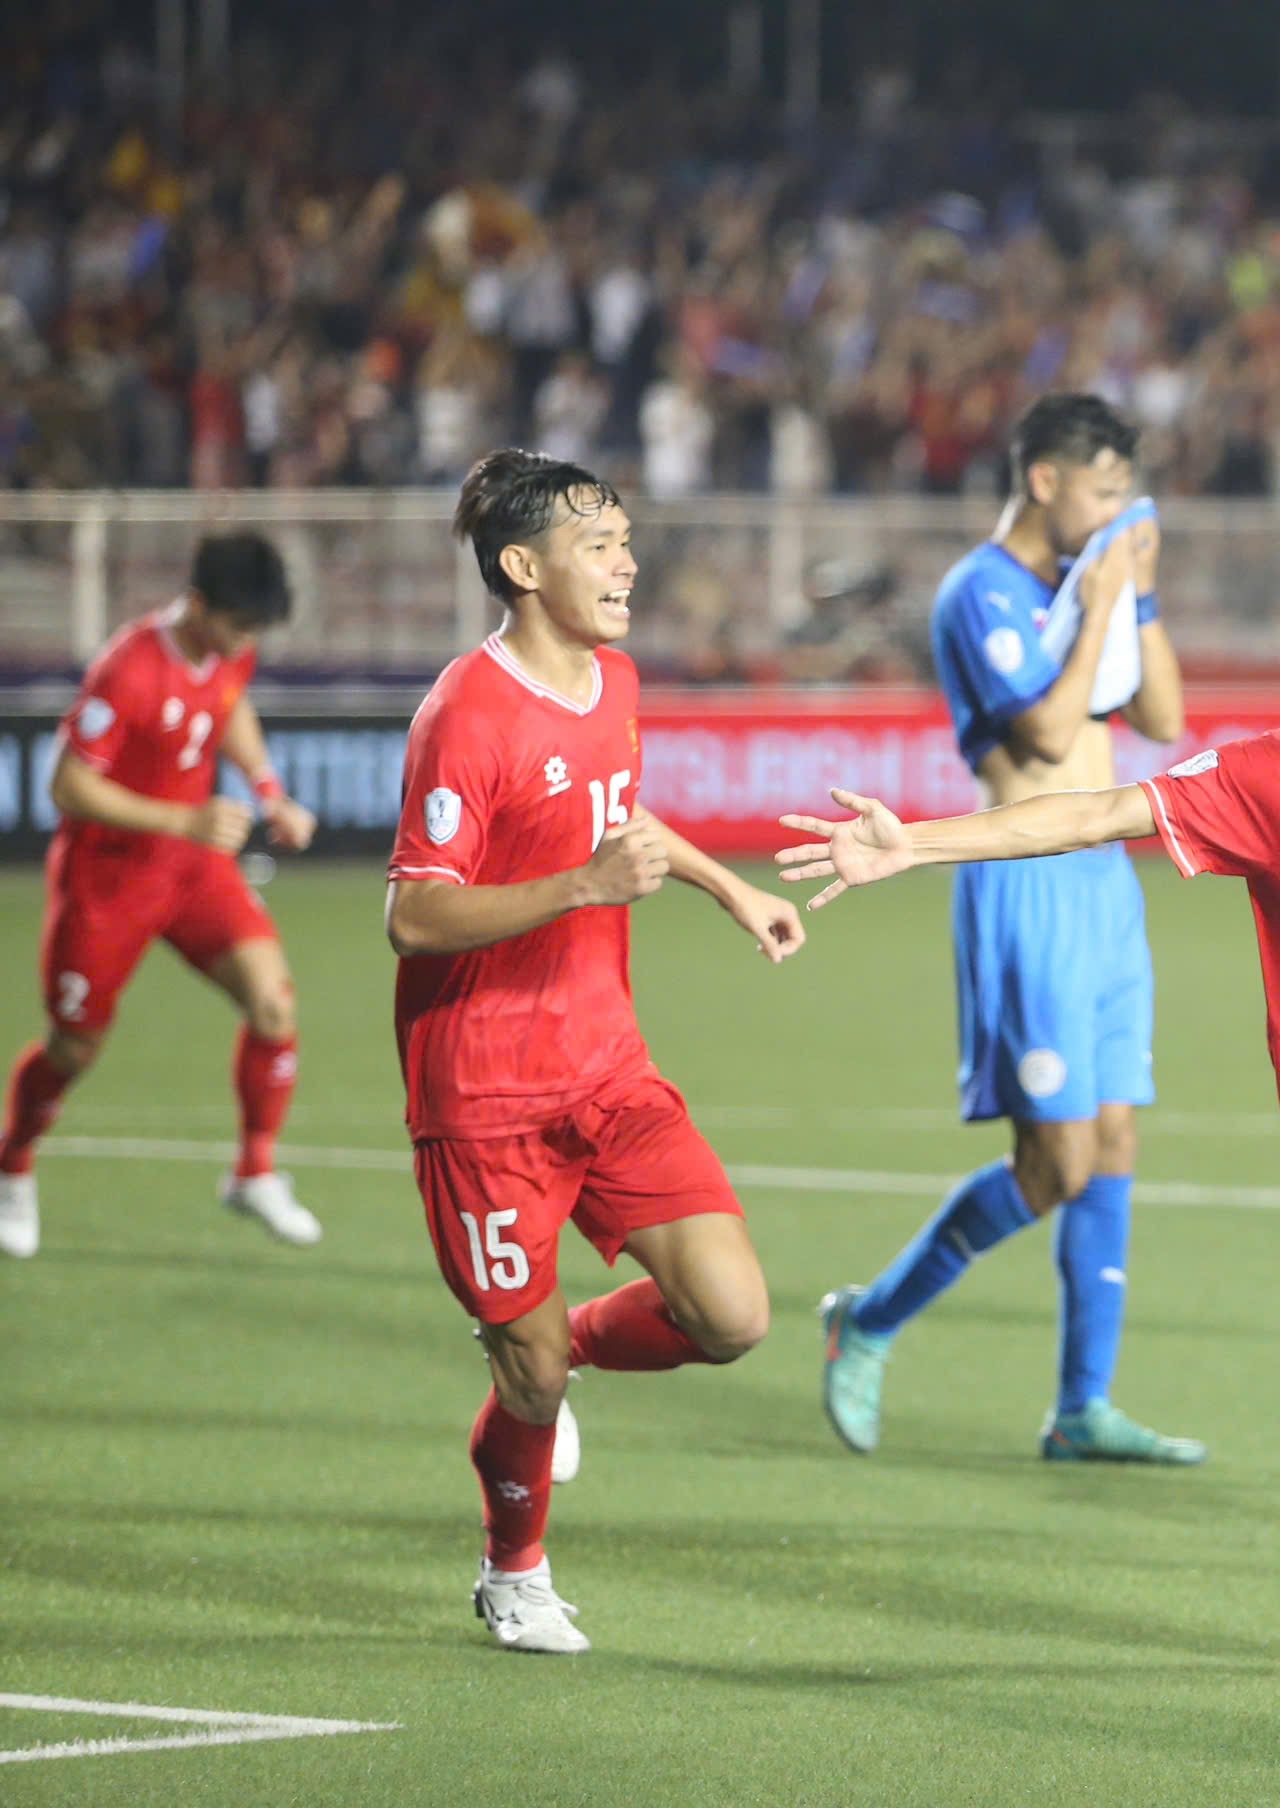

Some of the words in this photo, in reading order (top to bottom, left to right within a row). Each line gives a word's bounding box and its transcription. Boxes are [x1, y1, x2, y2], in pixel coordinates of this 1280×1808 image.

[178, 709, 214, 771] 2
[58, 970, 91, 1022] 2
[460, 1208, 530, 1291] 15
